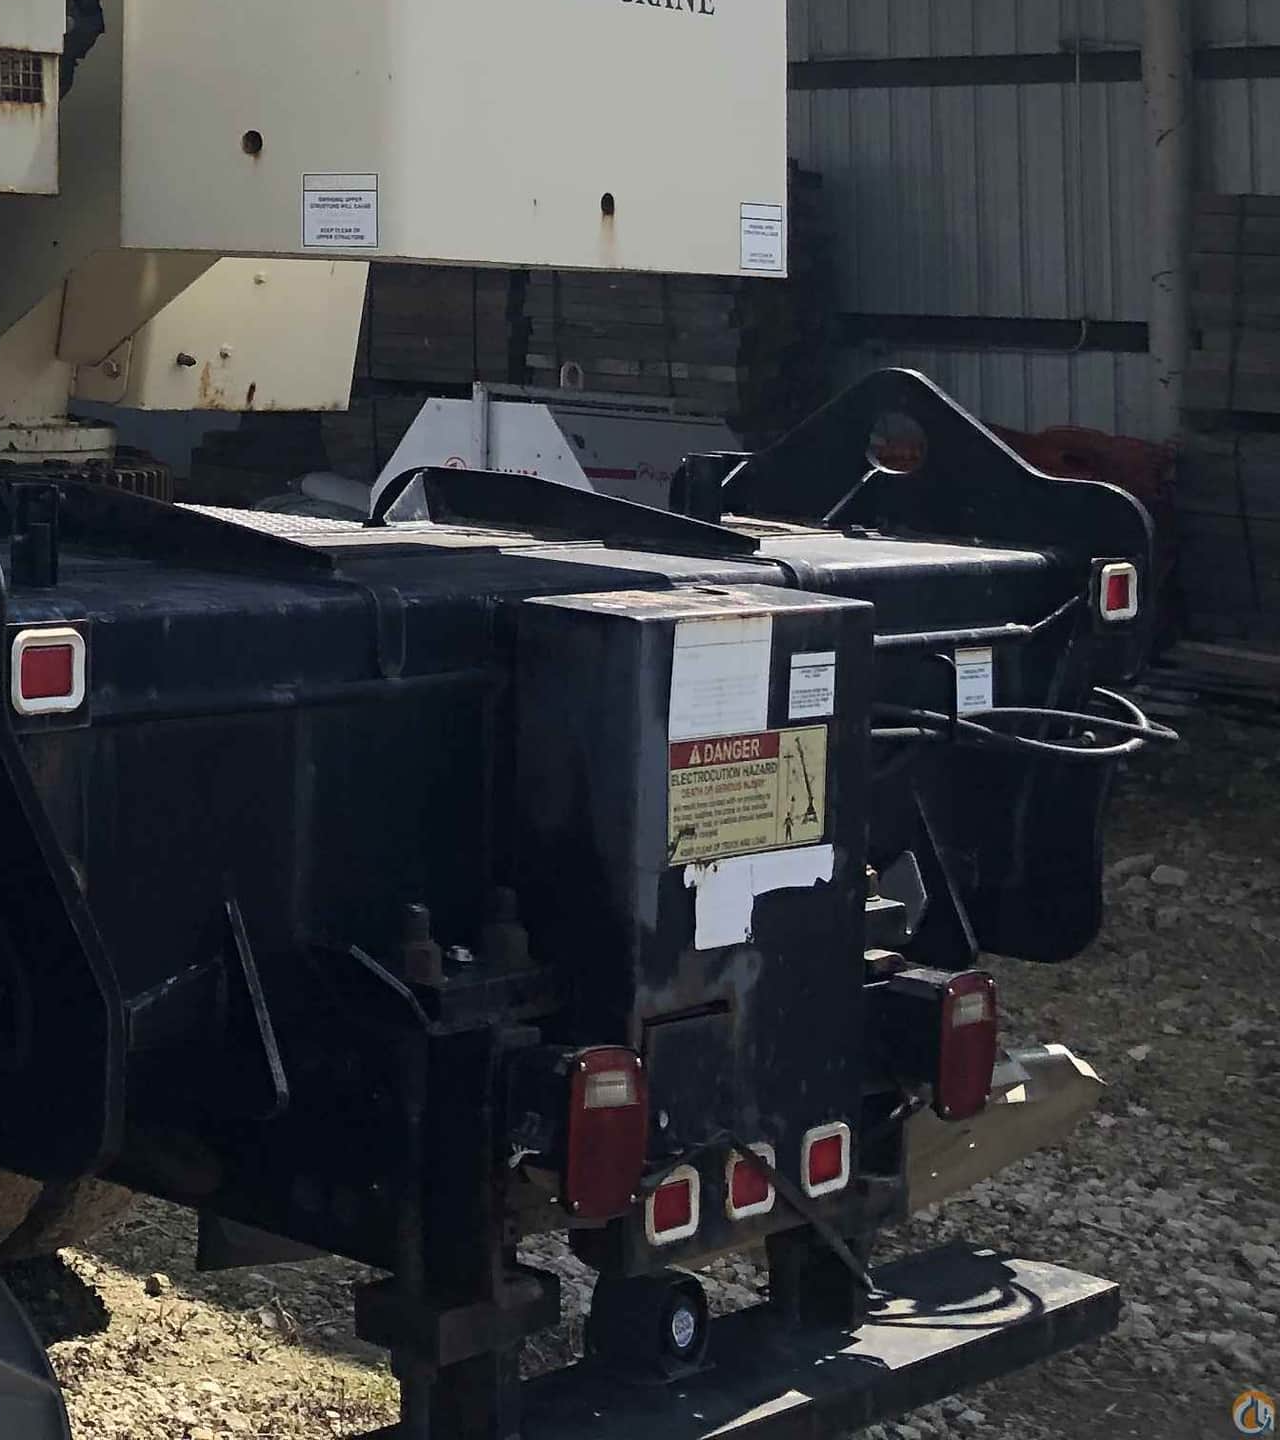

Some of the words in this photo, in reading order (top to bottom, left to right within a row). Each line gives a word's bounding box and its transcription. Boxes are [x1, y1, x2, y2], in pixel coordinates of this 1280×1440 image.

[704, 738, 760, 763] DANGER
[671, 766, 740, 786] ELECTROCUTION
[742, 762, 778, 777] HAZARD
